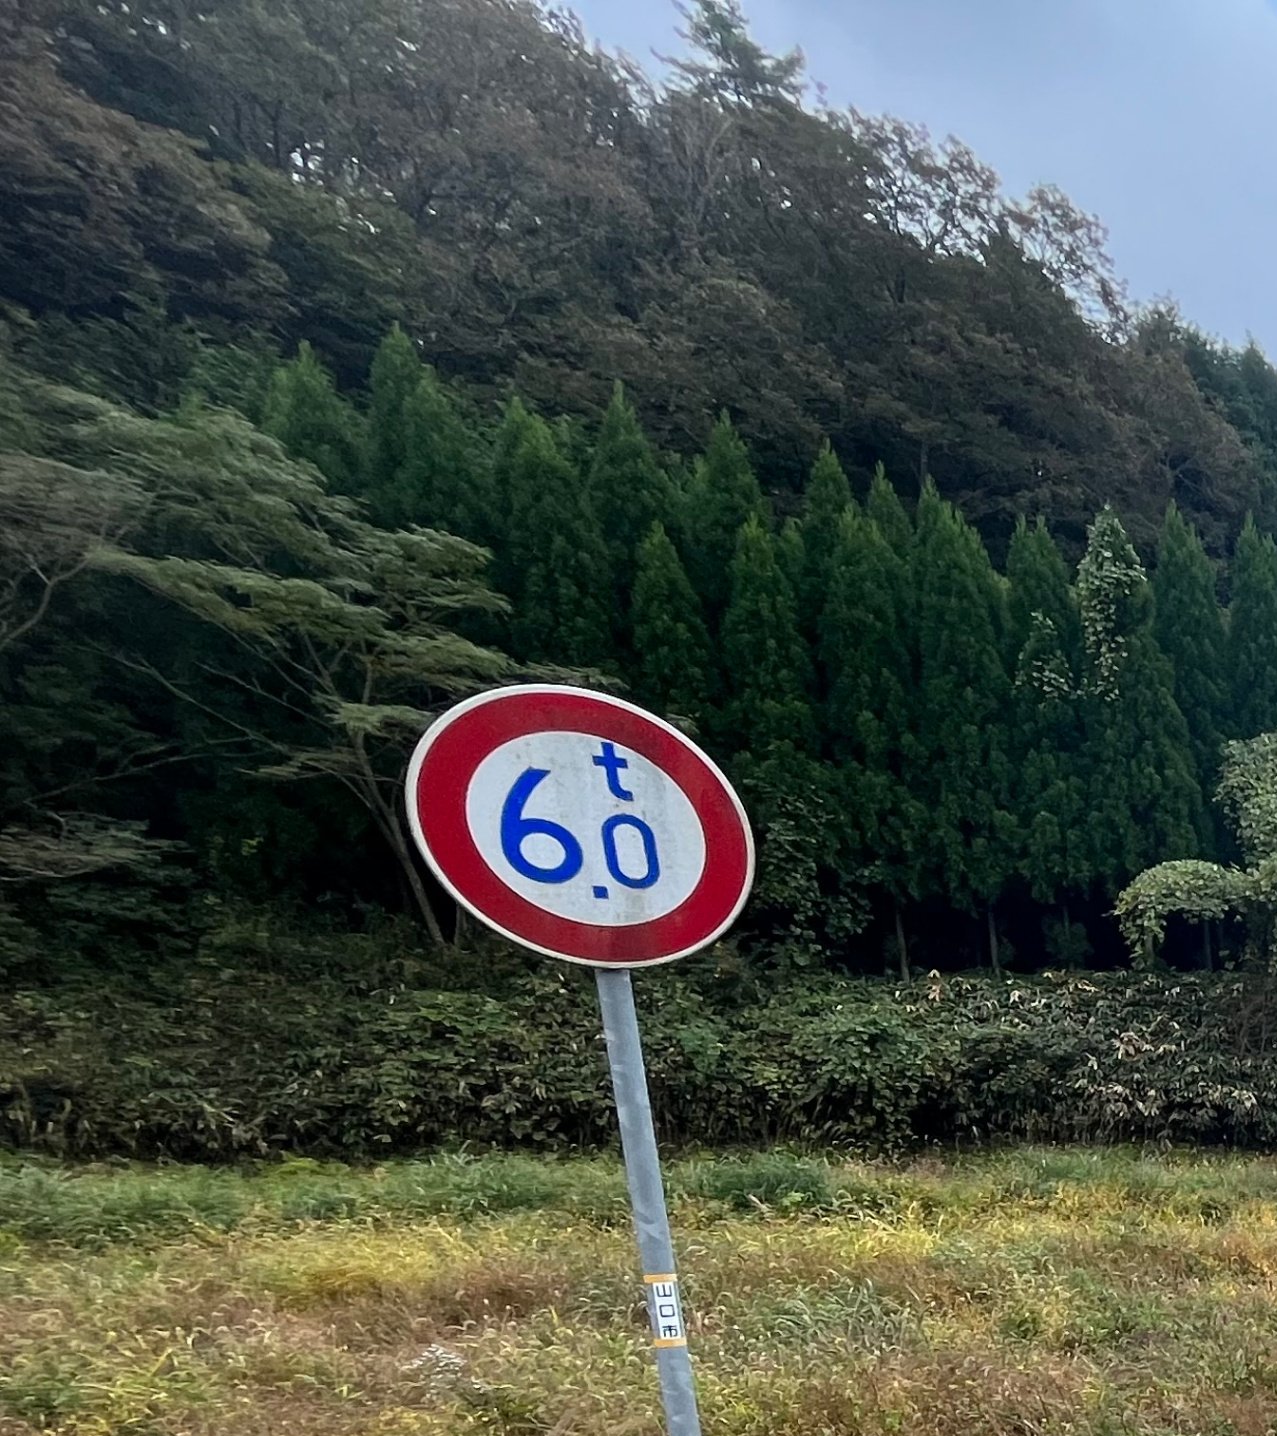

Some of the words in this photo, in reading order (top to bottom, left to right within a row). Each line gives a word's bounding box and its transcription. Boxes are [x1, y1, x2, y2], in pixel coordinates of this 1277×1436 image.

[592, 741, 634, 802] t
[500, 766, 661, 900] 6.0
[656, 1283, 679, 1338] 山口市
